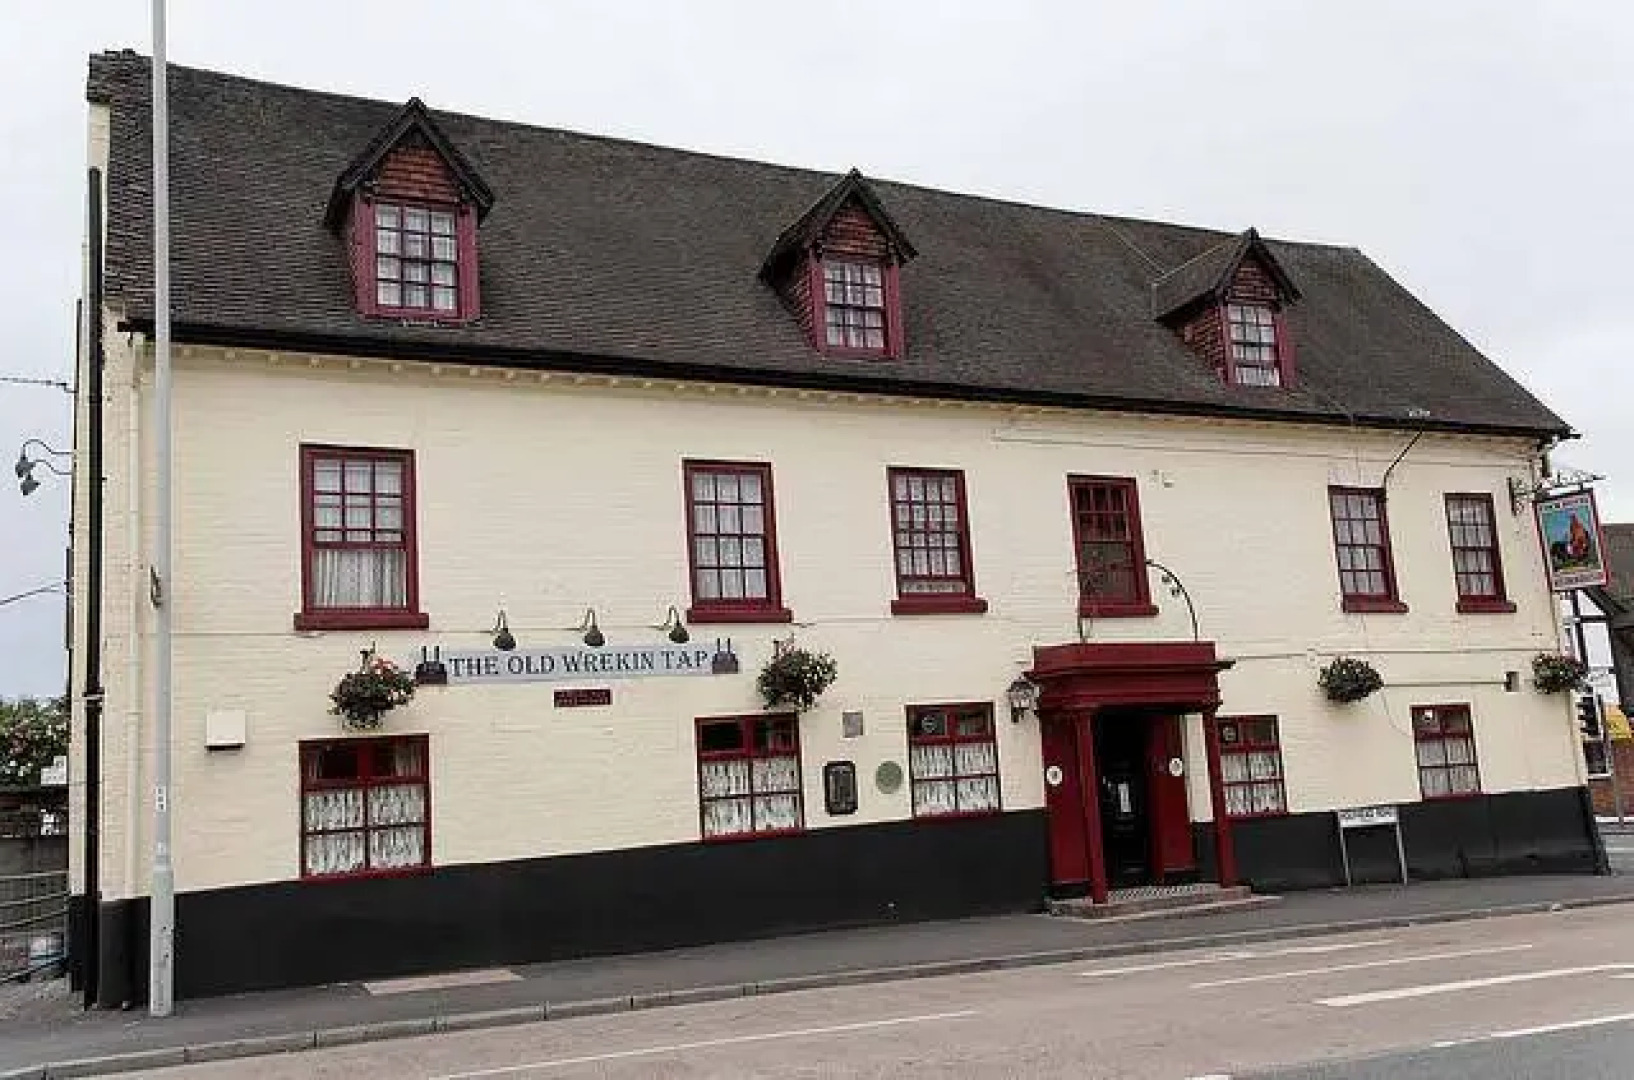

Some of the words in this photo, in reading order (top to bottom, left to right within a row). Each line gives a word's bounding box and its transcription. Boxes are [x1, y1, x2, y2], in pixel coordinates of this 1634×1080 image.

[449, 656, 499, 677] THE
[507, 653, 556, 676] OLD
[562, 649, 655, 674] WREKIN
[661, 649, 709, 670] TAP
